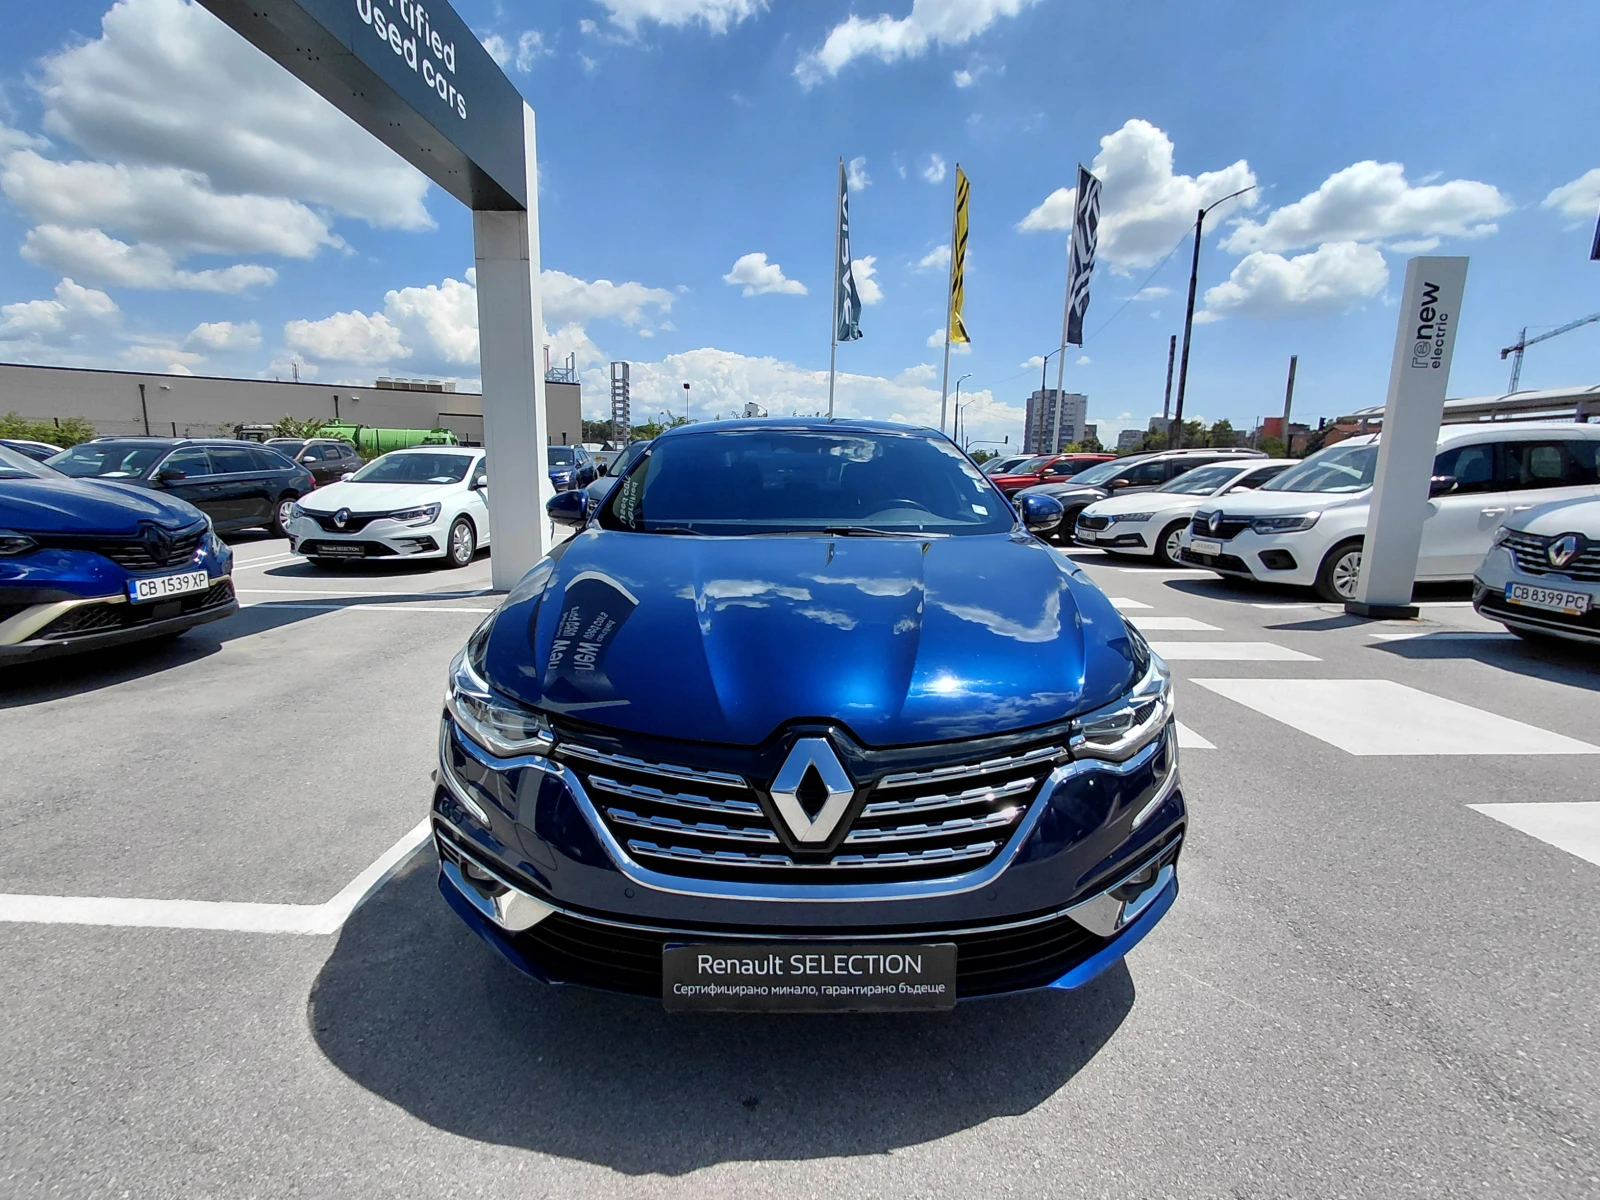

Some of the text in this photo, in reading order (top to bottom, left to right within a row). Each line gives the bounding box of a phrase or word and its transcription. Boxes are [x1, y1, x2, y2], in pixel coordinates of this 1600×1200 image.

[388, 0, 456, 75] tified
[422, 58, 467, 120] cars
[1411, 281, 1441, 369] renew
[1431, 312, 1449, 369] electric
[139, 573, 206, 597] CB 1539 XP
[1513, 586, 1585, 610] CB 8399 PC
[697, 954, 922, 975] Renault SELECTION
[673, 981, 946, 998] Сертифицирано минало, гарантирано бъдеще
